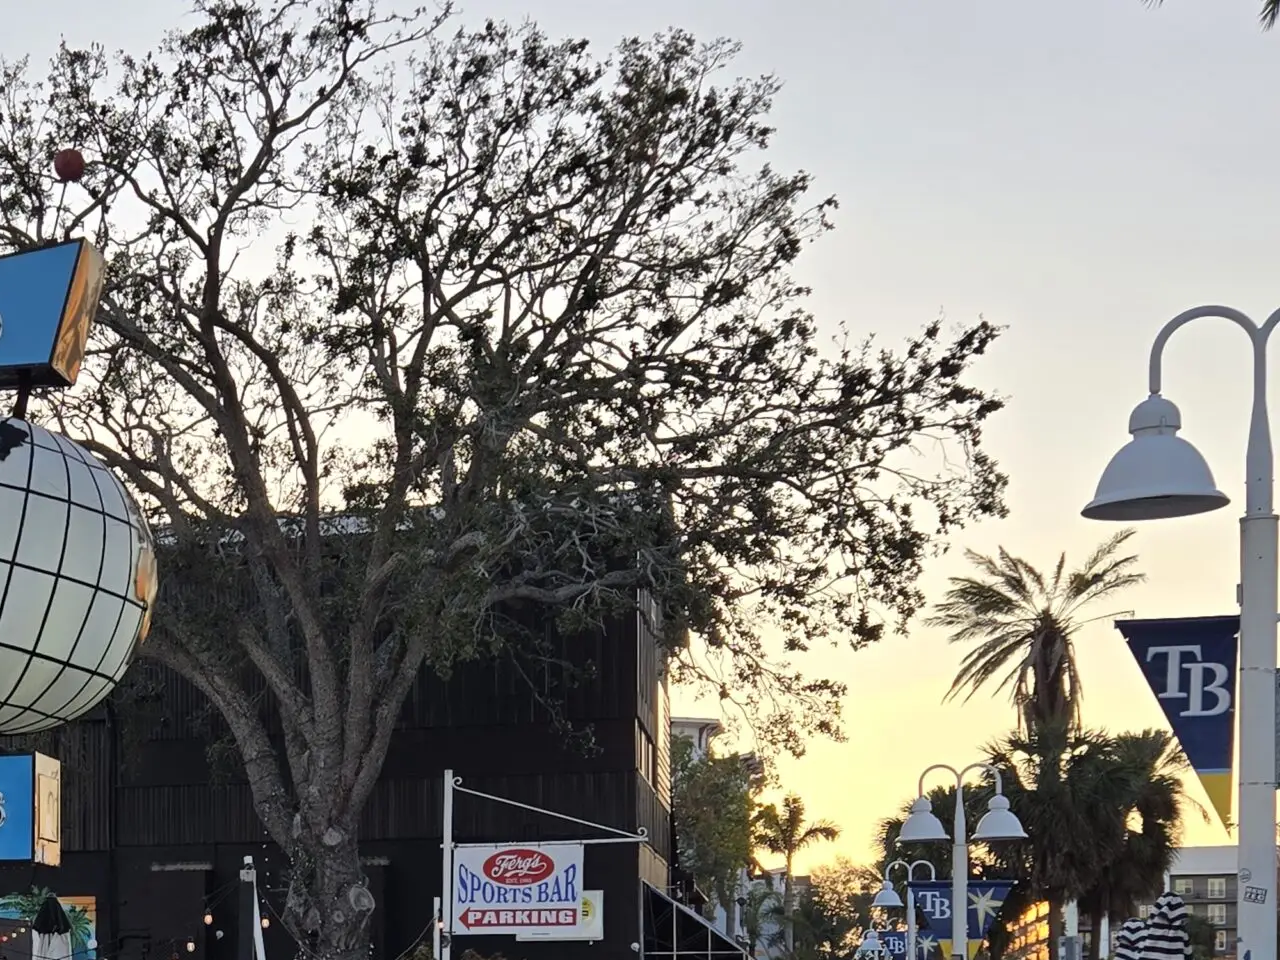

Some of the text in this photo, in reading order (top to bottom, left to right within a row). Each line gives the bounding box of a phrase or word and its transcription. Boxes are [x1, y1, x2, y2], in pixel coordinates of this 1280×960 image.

[1146, 645, 1231, 717] TB
[491, 854, 548, 877] Ferg's
[458, 863, 578, 904] SPORTS BAR
[467, 910, 574, 925] PARKING
[918, 891, 951, 919] TB
[884, 936, 905, 954] TB
